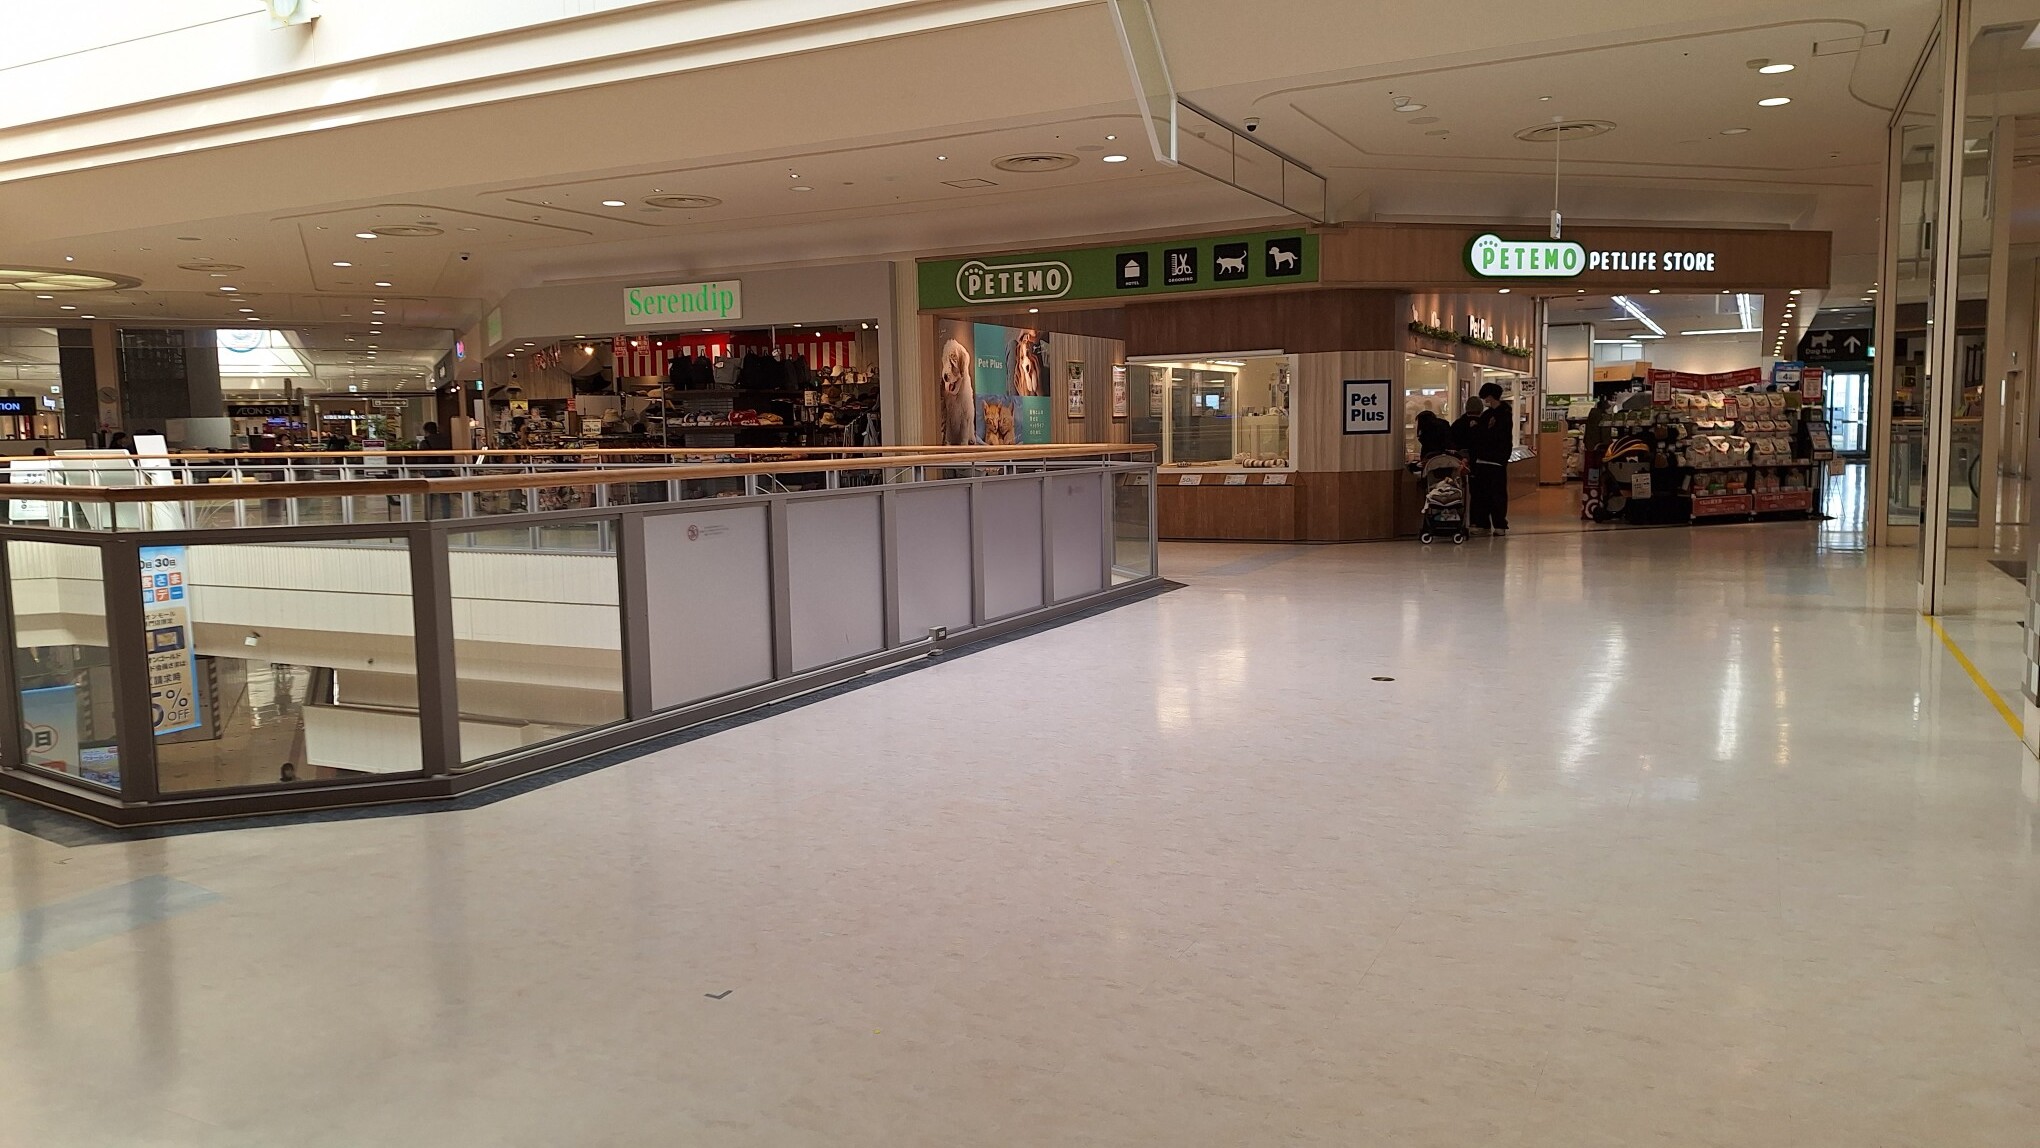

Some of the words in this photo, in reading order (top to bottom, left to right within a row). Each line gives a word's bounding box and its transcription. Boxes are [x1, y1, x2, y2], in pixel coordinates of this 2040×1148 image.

[1483, 247, 1577, 270] PETEMO
[1589, 251, 1656, 270] PETLIFE
[1663, 252, 1715, 271] STORE
[968, 268, 1058, 296] PETEMO
[629, 283, 734, 318] Serendip
[1469, 315, 1480, 338] Pet
[978, 358, 989, 369] Pet
[990, 358, 1003, 369] Plus
[1351, 393, 1377, 406] Pet
[265, 406, 295, 414] STYLE
[1351, 408, 1384, 421] Plus
[155, 558, 176, 567] 30日
[167, 708, 190, 722] OFF
